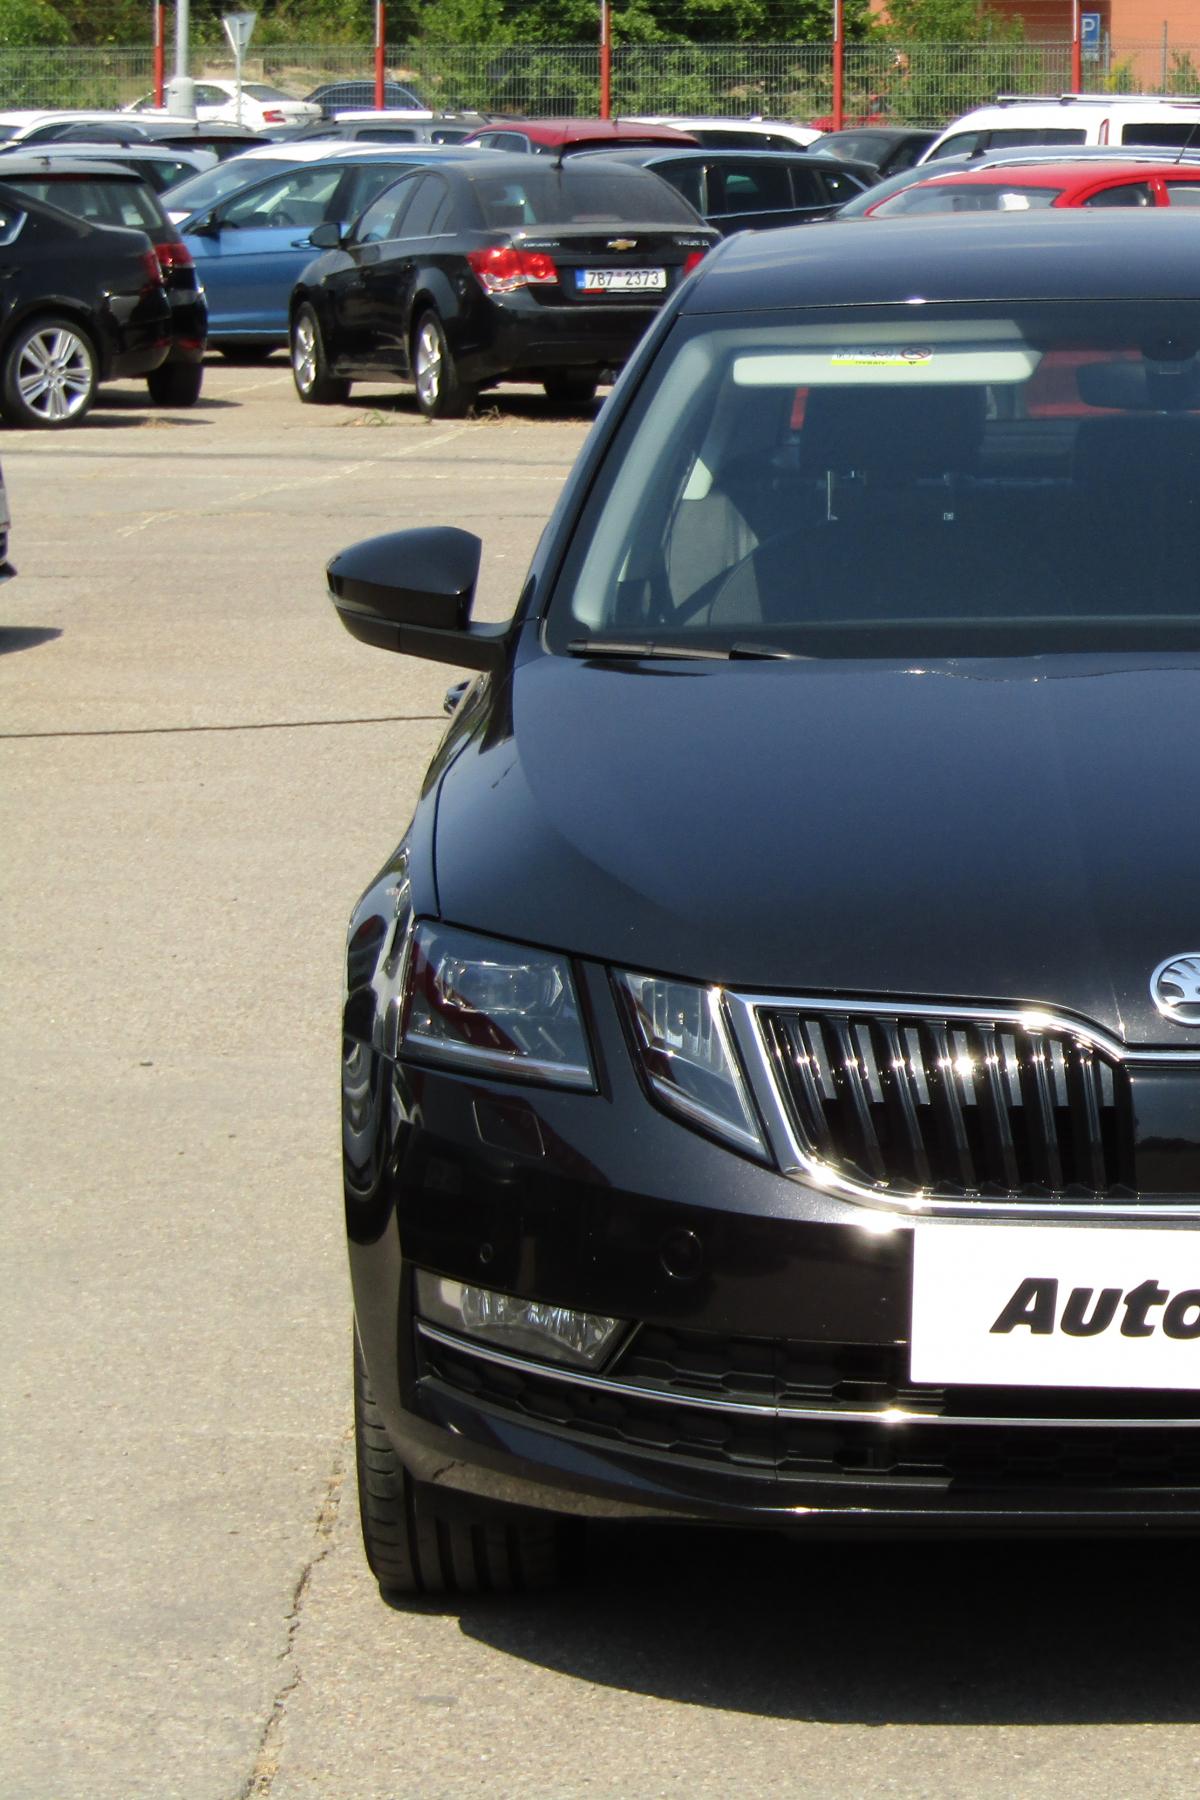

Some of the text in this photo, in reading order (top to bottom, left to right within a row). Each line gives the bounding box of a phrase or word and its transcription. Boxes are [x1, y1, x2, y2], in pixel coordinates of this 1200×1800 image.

[1081, 18, 1095, 39] P
[588, 271, 659, 286] 7B7 2373
